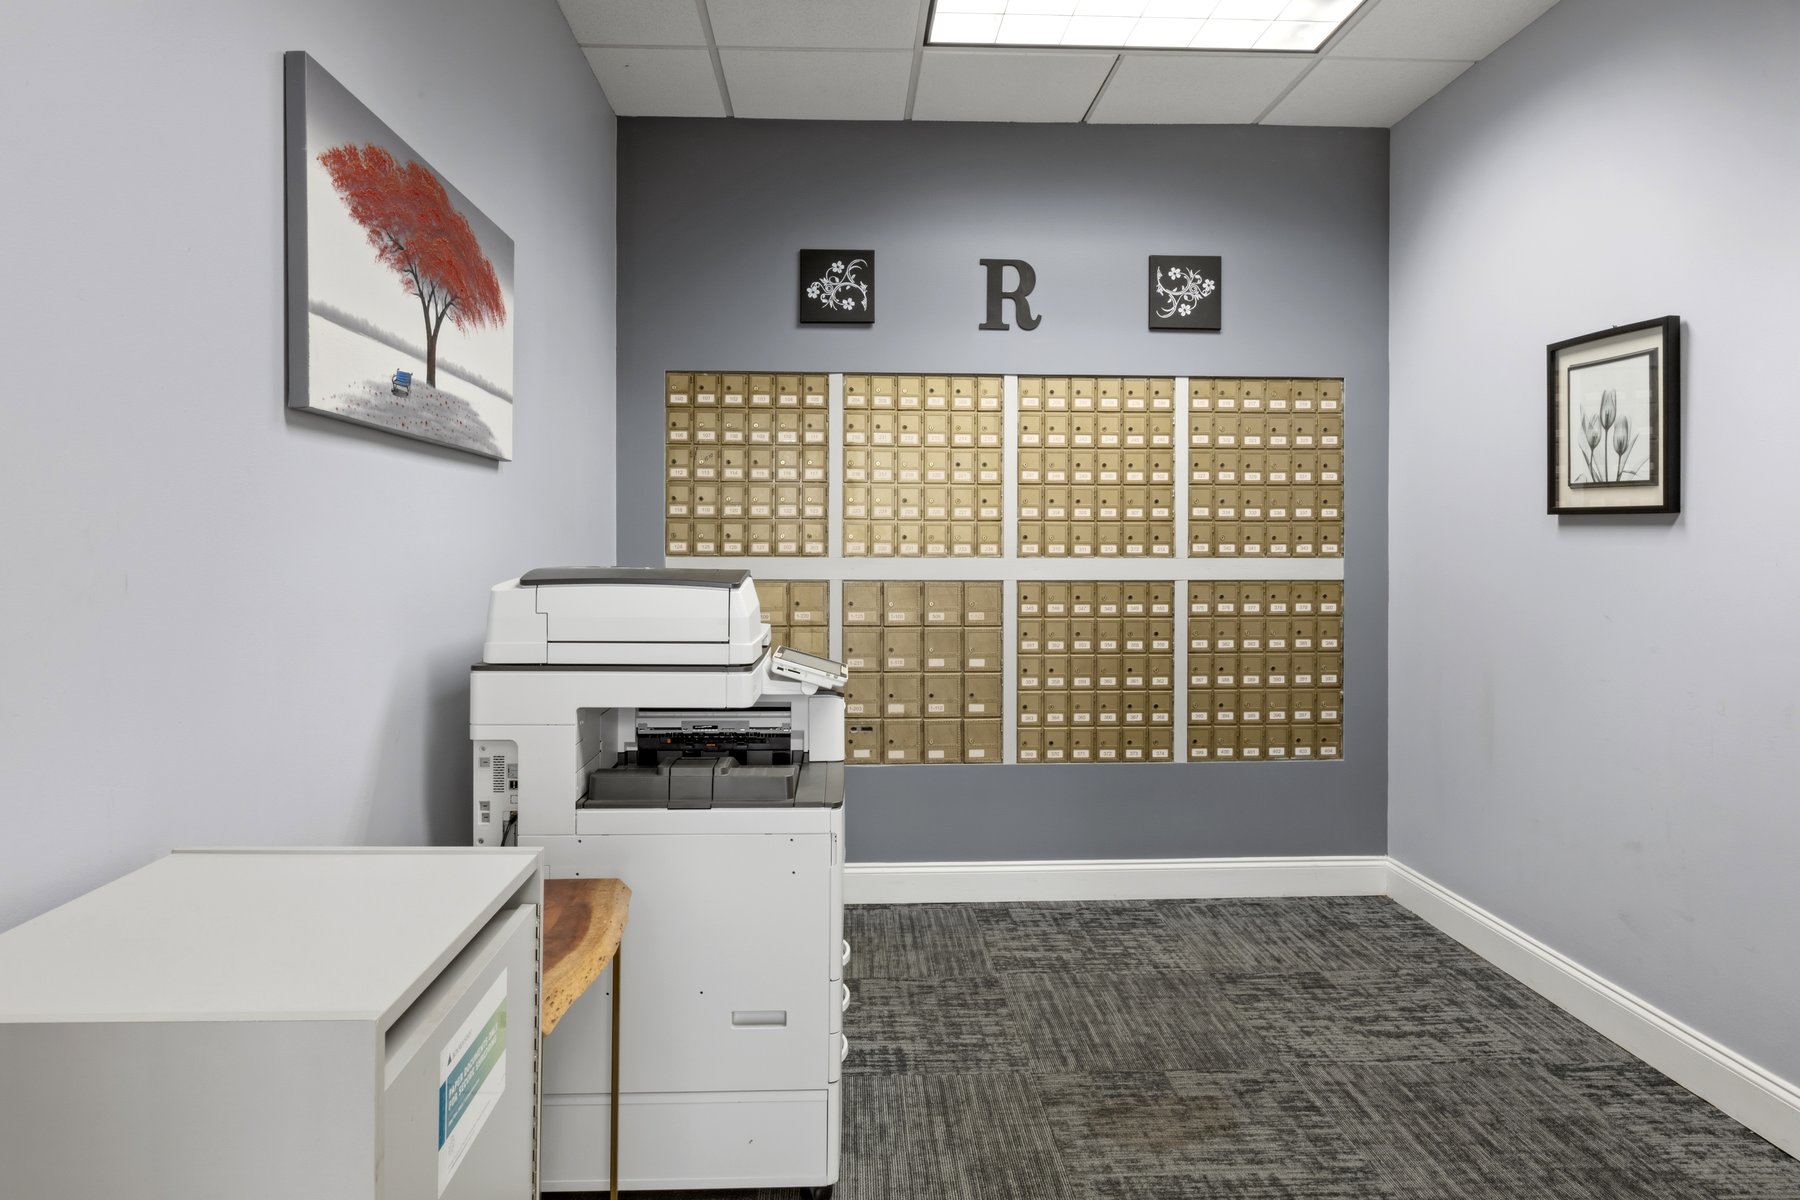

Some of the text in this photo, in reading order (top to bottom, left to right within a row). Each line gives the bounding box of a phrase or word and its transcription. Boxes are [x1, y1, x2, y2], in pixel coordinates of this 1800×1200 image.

[979, 258, 1042, 330] R
[449, 1071, 463, 1099] PAPER
[464, 1036, 487, 1077] DOCUMENTS
[449, 1090, 458, 1111] FOR
[458, 1066, 475, 1096] SECURE
